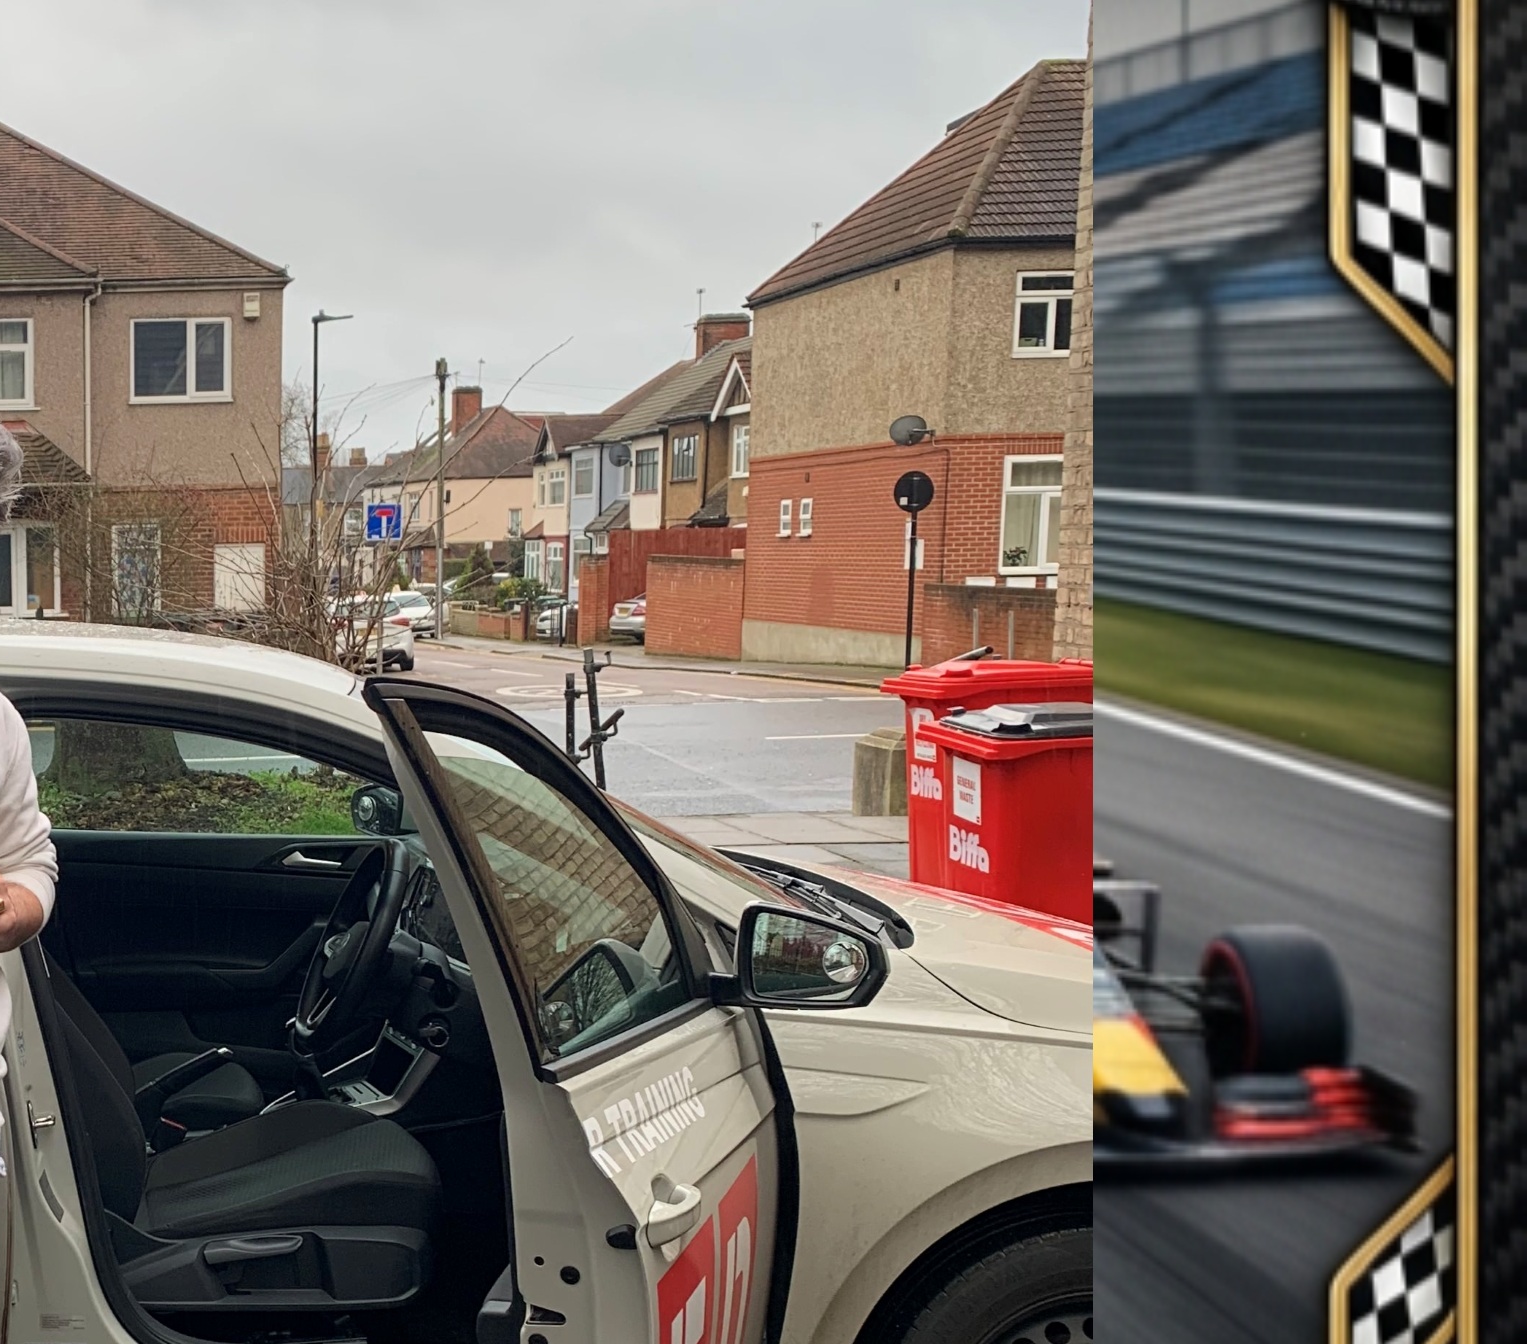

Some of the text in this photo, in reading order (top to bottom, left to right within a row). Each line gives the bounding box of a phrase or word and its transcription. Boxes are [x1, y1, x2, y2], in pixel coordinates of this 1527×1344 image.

[910, 763, 943, 801] Biffa
[957, 775, 976, 792] GENERAL
[959, 789, 974, 805] WASTE
[949, 823, 990, 874] Biffa
[603, 1066, 705, 1163] TRAINING
